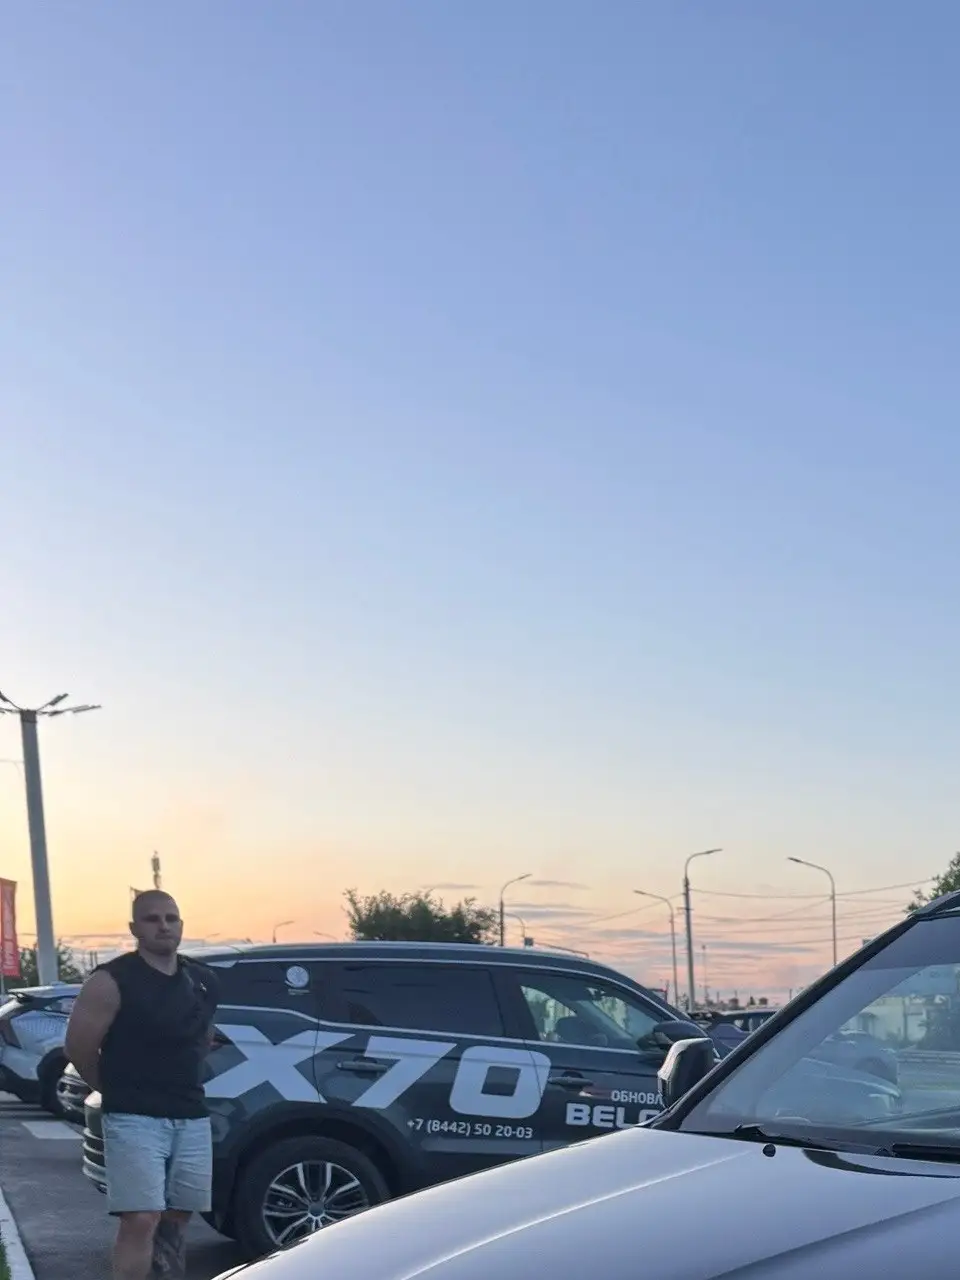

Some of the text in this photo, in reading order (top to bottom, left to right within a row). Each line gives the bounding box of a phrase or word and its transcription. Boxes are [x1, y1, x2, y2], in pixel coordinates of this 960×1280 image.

[203, 1024, 551, 1119] X70
[407, 1119, 533, 1139] +7 (8442) 50 20-03
